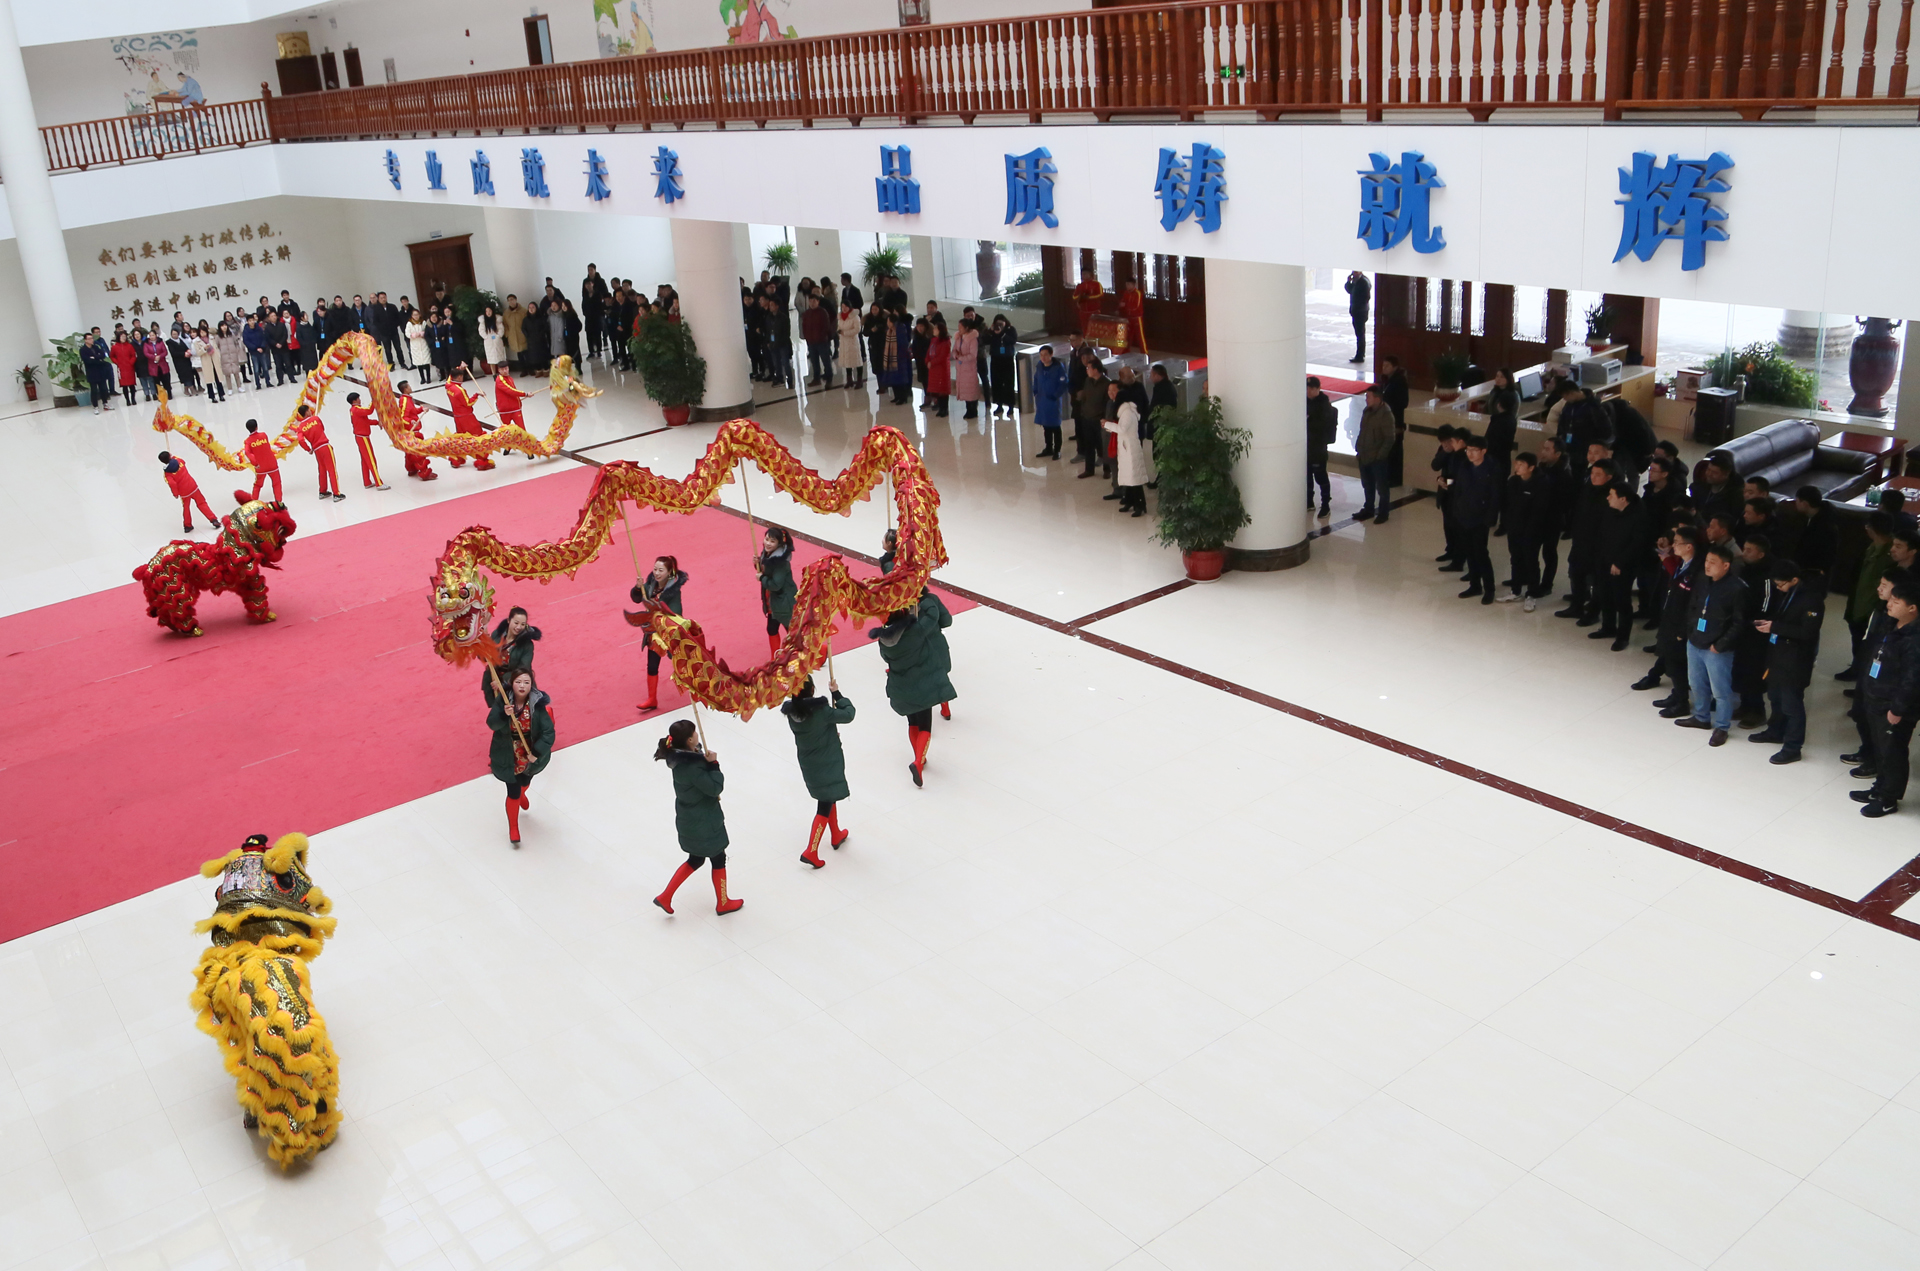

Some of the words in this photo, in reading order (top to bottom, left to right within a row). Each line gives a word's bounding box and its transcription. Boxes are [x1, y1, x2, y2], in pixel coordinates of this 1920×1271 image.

[382, 145, 686, 205] 专业成就未来
[876, 143, 1736, 271] 品质铸就辉
